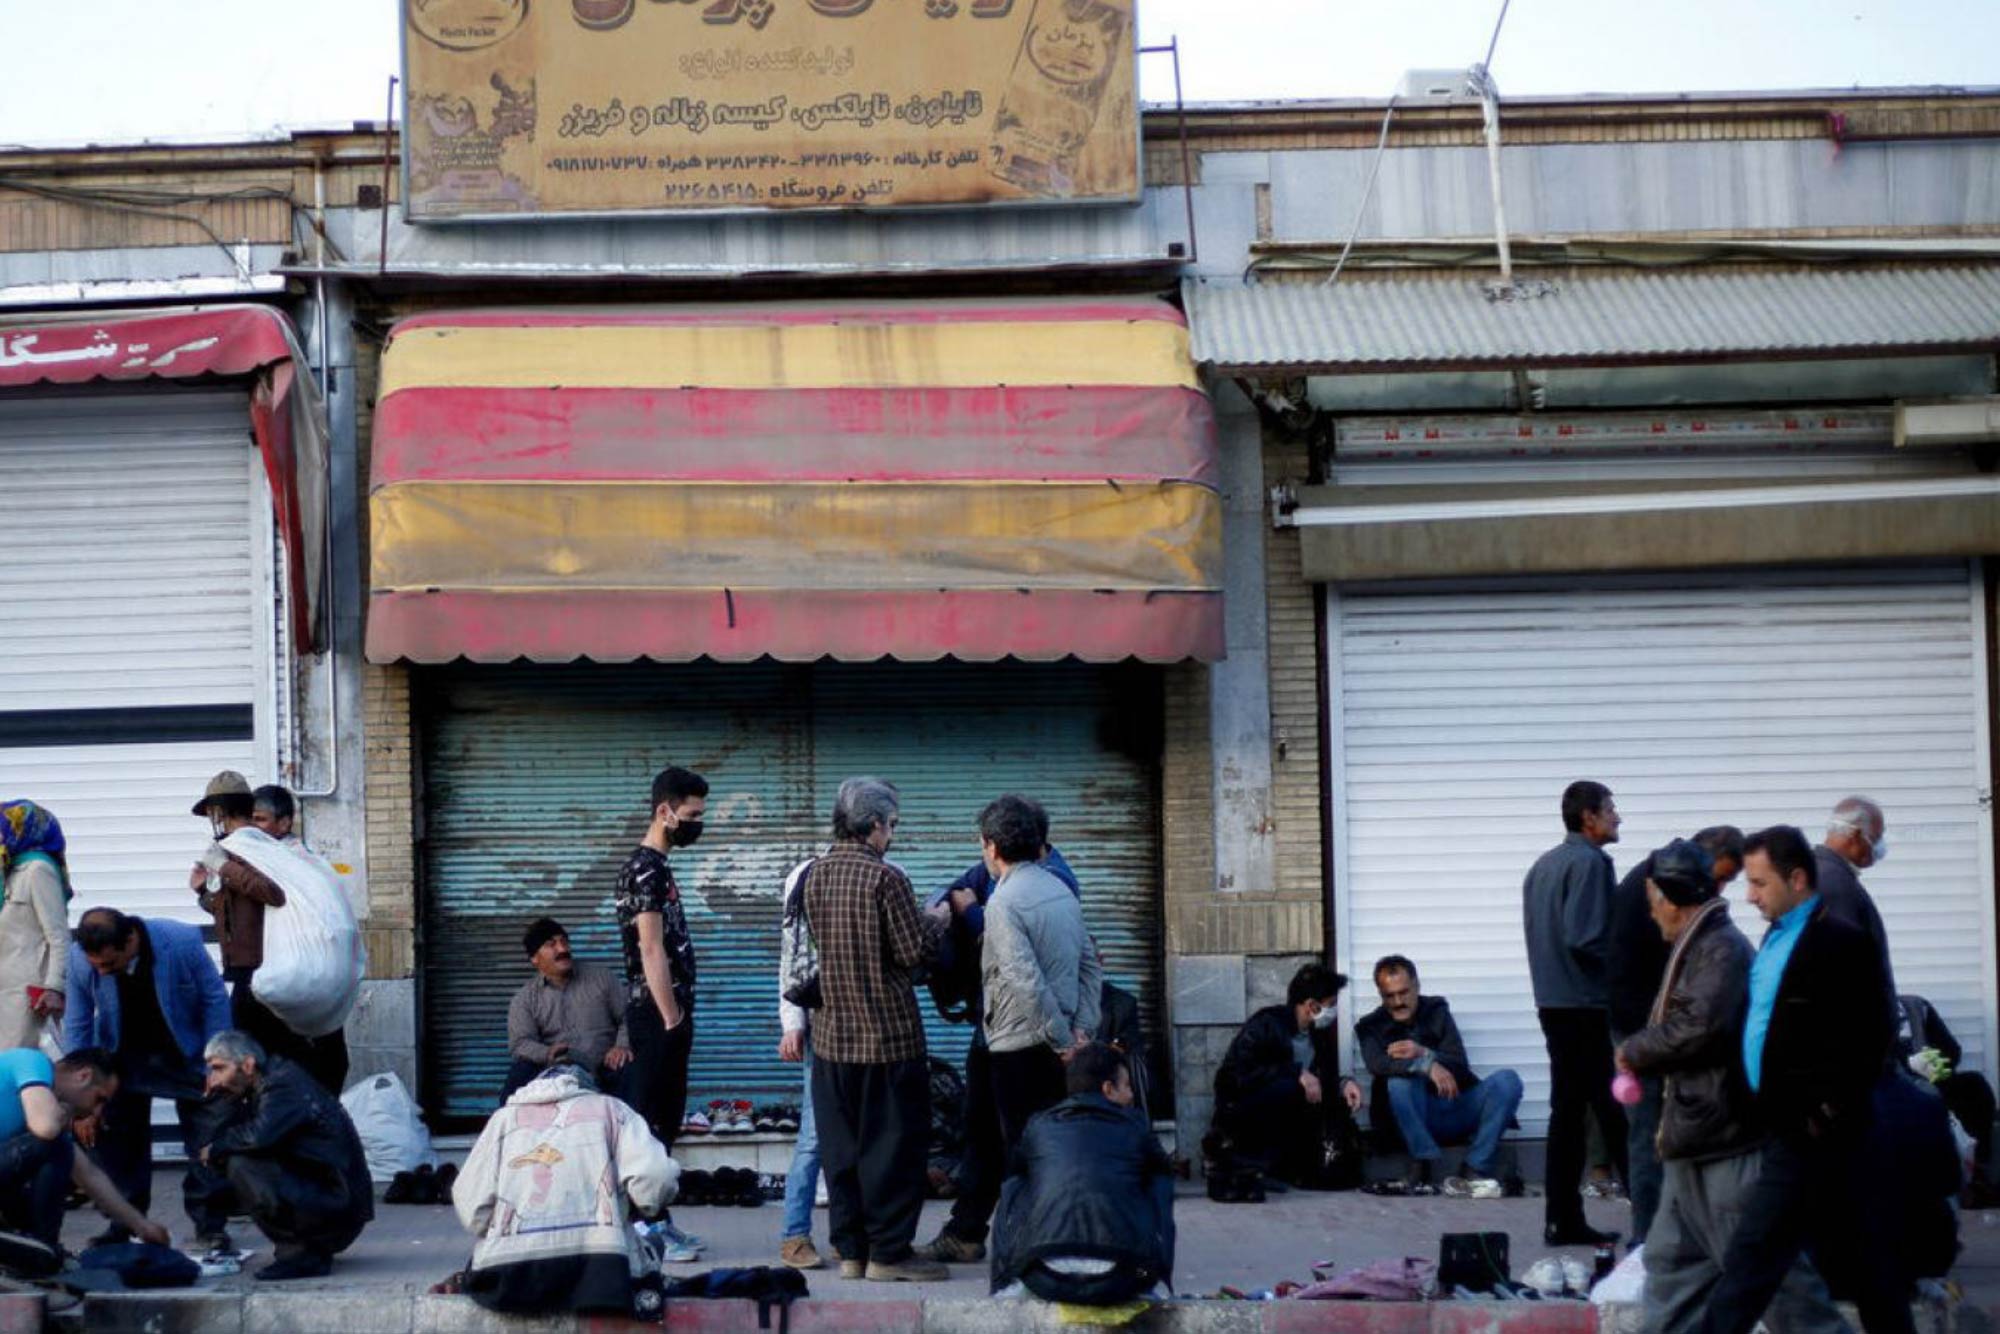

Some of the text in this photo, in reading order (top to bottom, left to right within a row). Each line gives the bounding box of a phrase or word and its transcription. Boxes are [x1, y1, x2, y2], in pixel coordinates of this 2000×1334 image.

[558, 98, 625, 138] فریزر
[629, 106, 649, 137] و
[653, 97, 710, 134] زباله
[712, 95, 787, 131] کیسه
[946, 150, 979, 168] تلفن
[852, 178, 893, 200] تلفن
